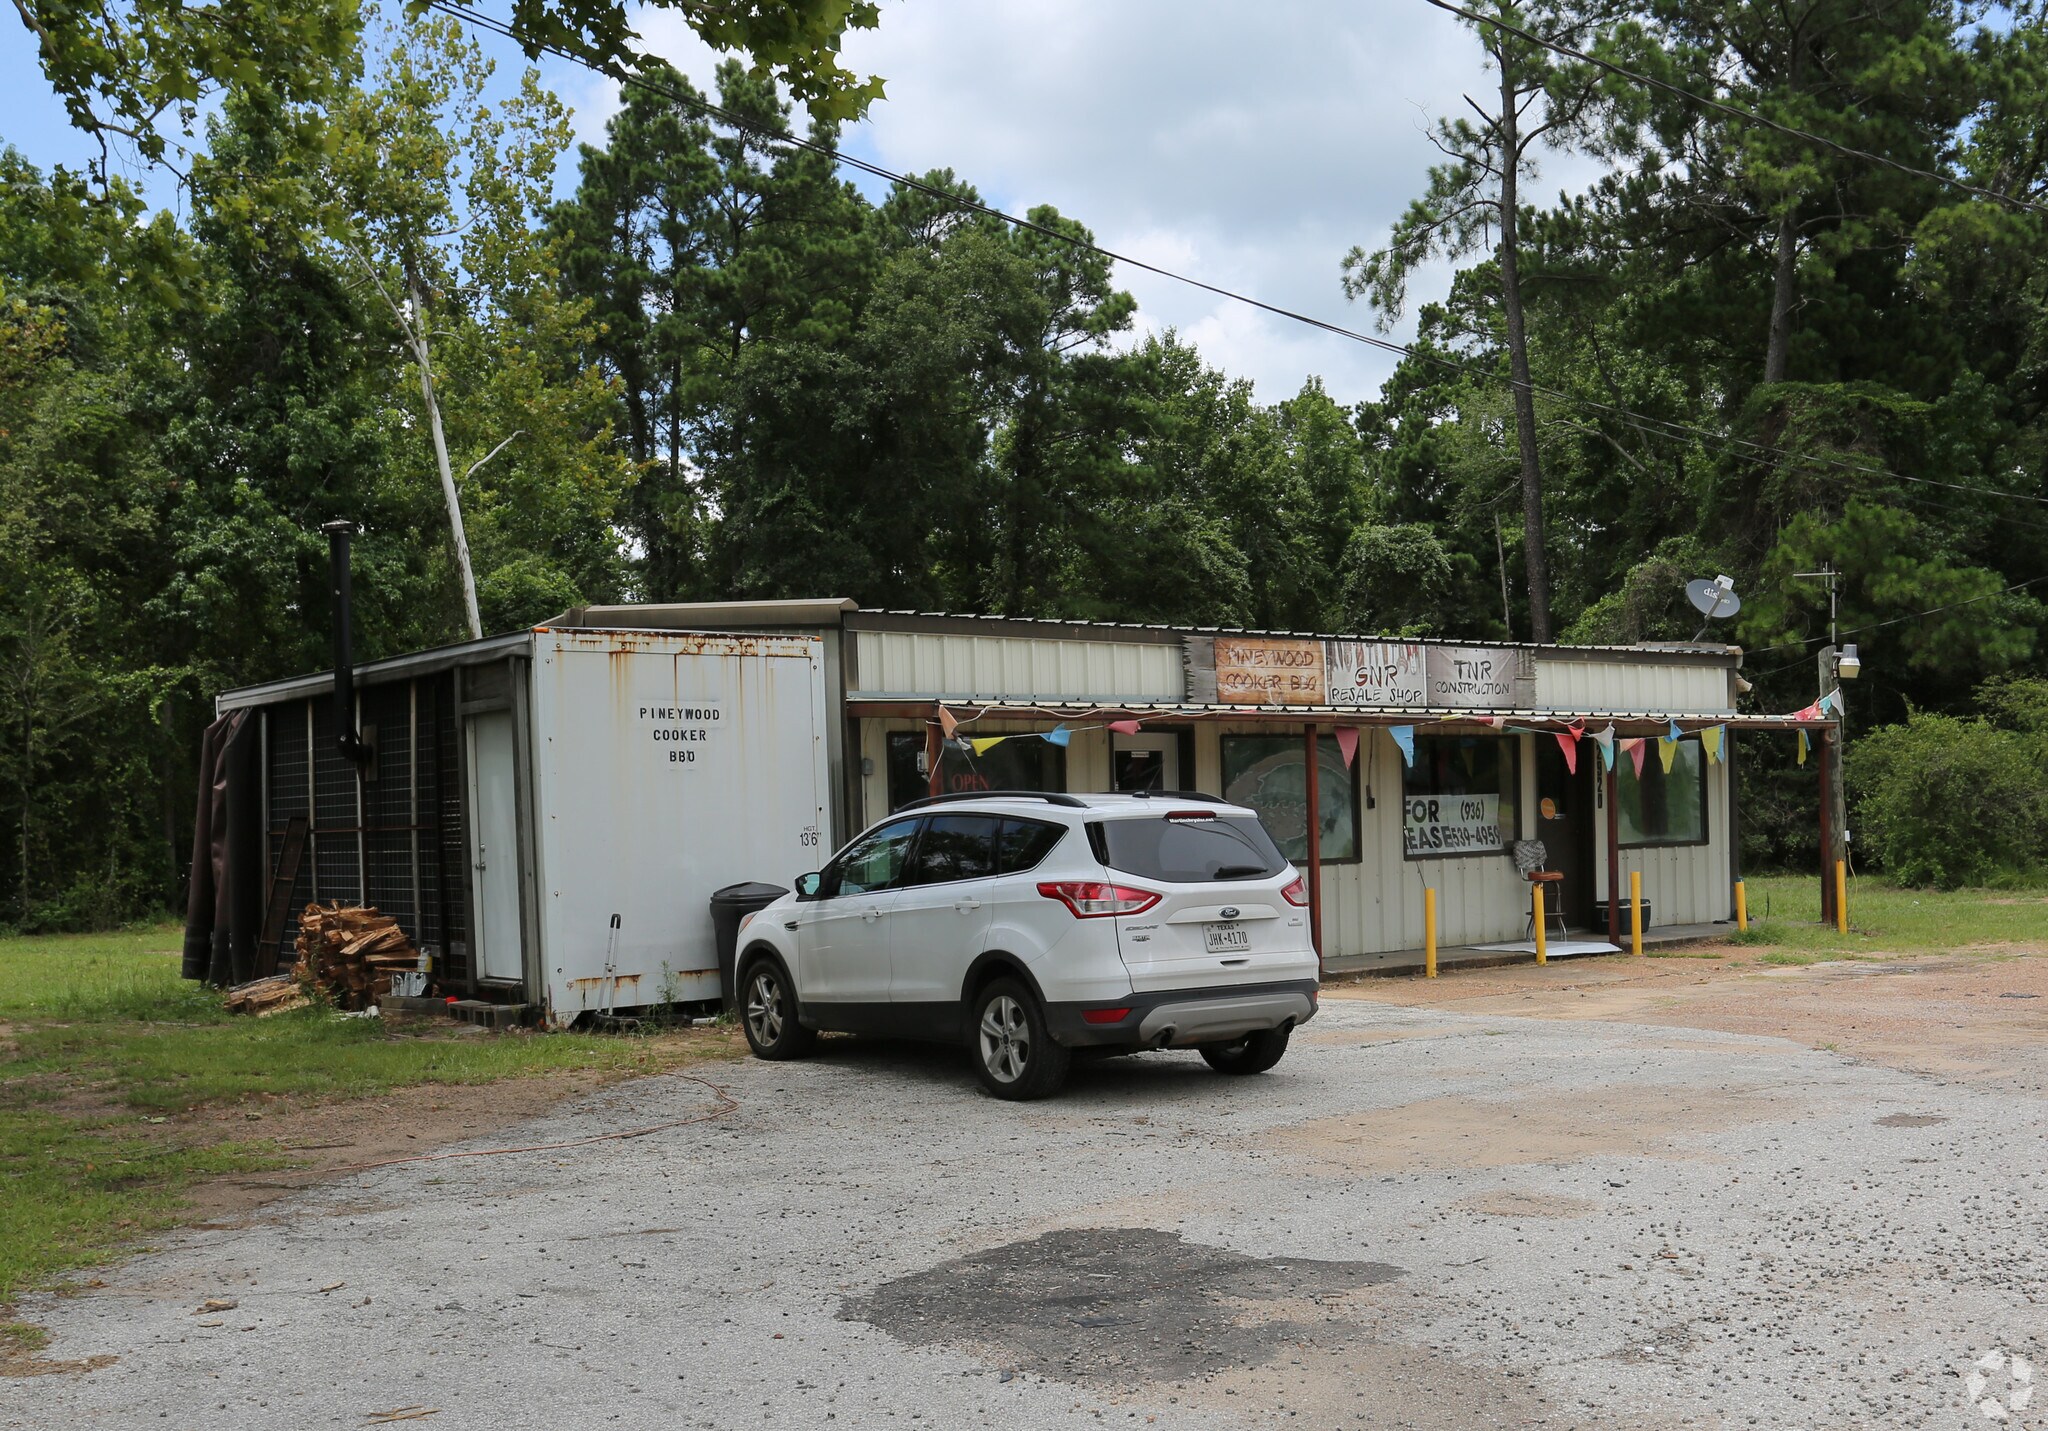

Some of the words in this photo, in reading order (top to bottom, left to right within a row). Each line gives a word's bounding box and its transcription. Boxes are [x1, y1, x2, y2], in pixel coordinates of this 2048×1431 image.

[1227, 649, 1314, 667] PINEYWOOD
[1354, 664, 1398, 688] GNR
[1453, 659, 1492, 681] TNR
[1226, 673, 1282, 691] COOKER
[1290, 675, 1317, 692] BBQ
[1435, 681, 1510, 696] CONSTRUCTION
[1331, 687, 1381, 702] RESALE
[1389, 688, 1422, 703] SHOP
[640, 707, 720, 720] PINEYWOOD
[653, 729, 706, 741] COOKER
[952, 773, 989, 792] OPEN
[1406, 799, 1440, 823] FOR
[1460, 799, 1485, 822] (936)
[1406, 826, 1454, 850] EASE
[1450, 825, 1501, 848] 539-4959
